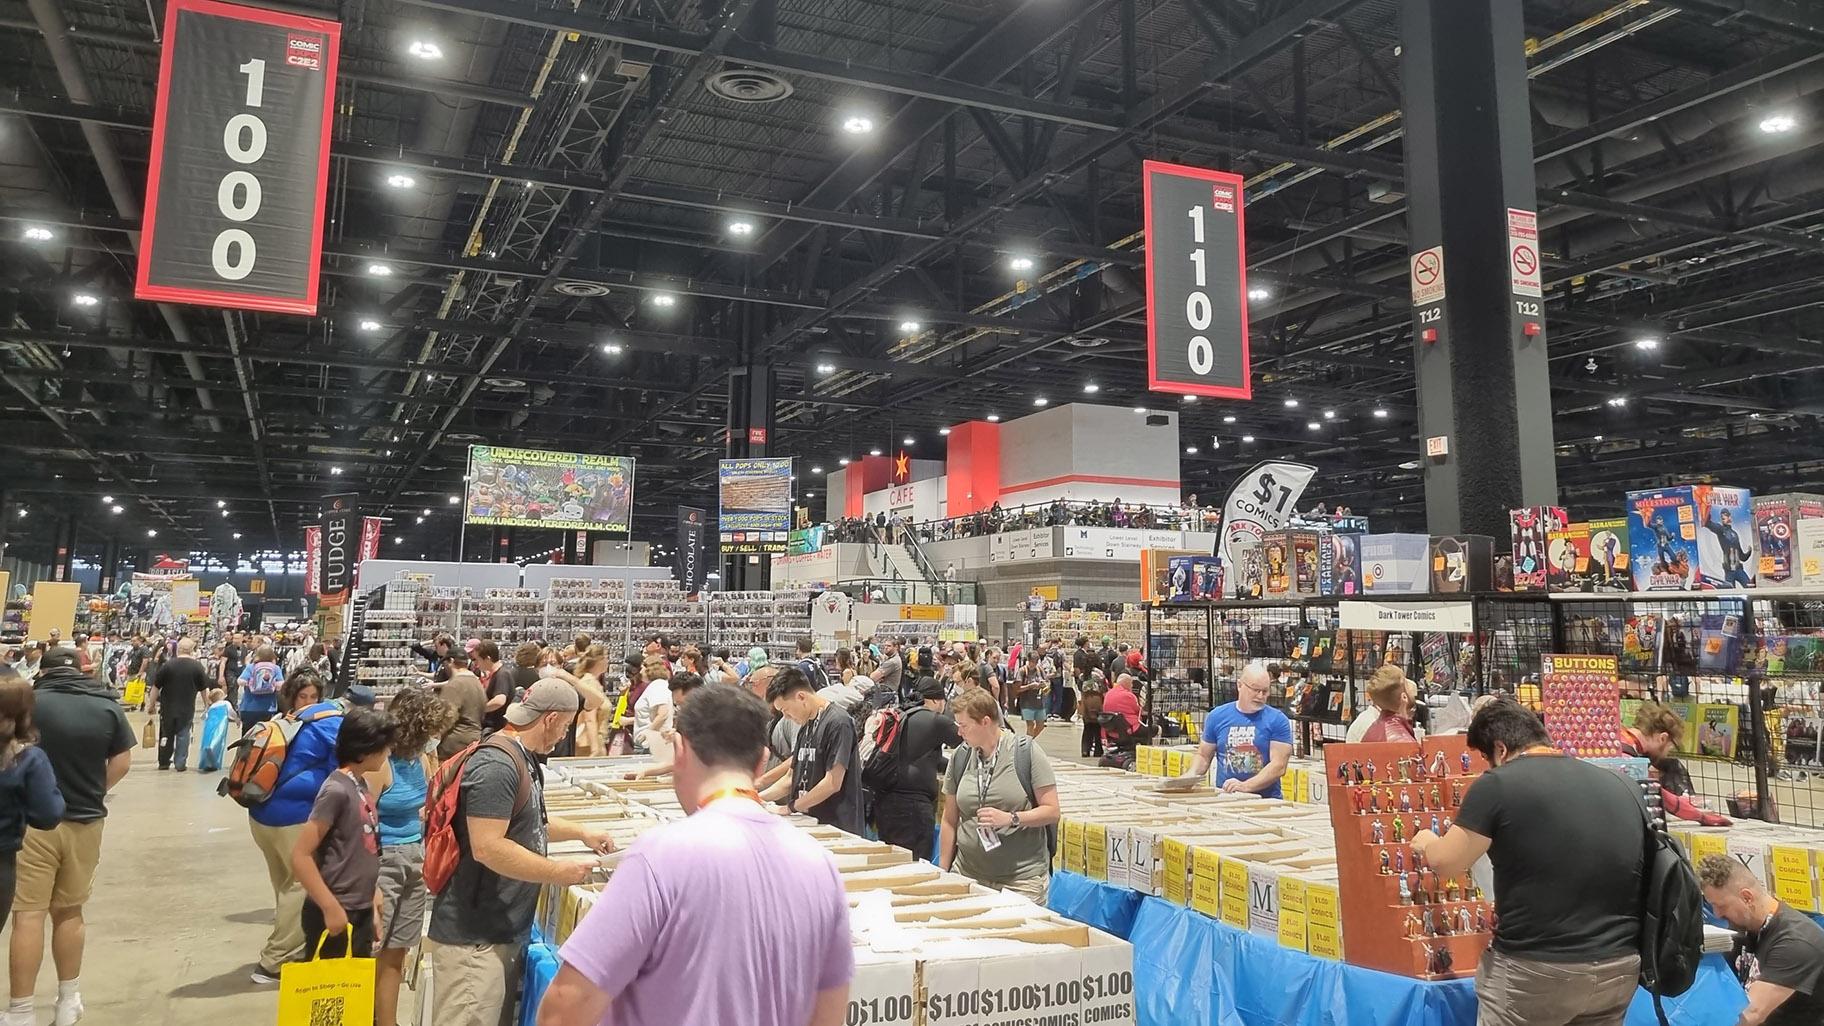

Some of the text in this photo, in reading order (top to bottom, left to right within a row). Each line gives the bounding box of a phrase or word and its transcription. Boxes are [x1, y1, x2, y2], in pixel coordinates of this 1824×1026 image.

[290, 40, 320, 49] COMIC
[288, 56, 318, 67] C2E2
[212, 58, 267, 280] 1000
[1186, 205, 1214, 375] 1100
[1421, 283, 1444, 296] SMOKING
[1419, 307, 1441, 323] T12
[1516, 301, 1539, 316] T12
[491, 448, 618, 466] UNDISCOVERED REALM
[889, 486, 915, 506] CAFE
[1253, 473, 1293, 514] $1
[1722, 492, 1739, 506] WAR
[1635, 497, 1685, 508] MILESTONES
[1236, 499, 1279, 528] COMICS
[468, 515, 627, 532] WWW.UNDISCOVEREDREALM.COM
[328, 518, 346, 590] FUDGE
[740, 544, 757, 552] SELL
[763, 544, 786, 552] TRADE
[685, 530, 696, 594] CHOCOLATE
[1378, 610, 1436, 620] Dark Tower Comics
[1554, 657, 1615, 670] BUTTONS
[1312, 782, 1323, 801] U
[1111, 837, 1124, 863] K
[1135, 840, 1145, 866] L
[1779, 866, 1806, 875] COMICS
[1252, 880, 1274, 913] M
[1282, 893, 1303, 904] COMICS
[1785, 887, 1802, 895] $1.00
[1314, 896, 1329, 905] $1.00
[1781, 897, 1809, 906] COMICS
[1311, 908, 1334, 919] COMICS
[1282, 929, 1303, 940] COMICS
[1316, 933, 1331, 943] $1.00
[1313, 944, 1336, 956] COMICS
[1082, 971, 1132, 1001] $1.00
[928, 989, 979, 1022] $1.00
[981, 984, 1035, 1017] $1.00
[1084, 1003, 1131, 1024] COMICS
